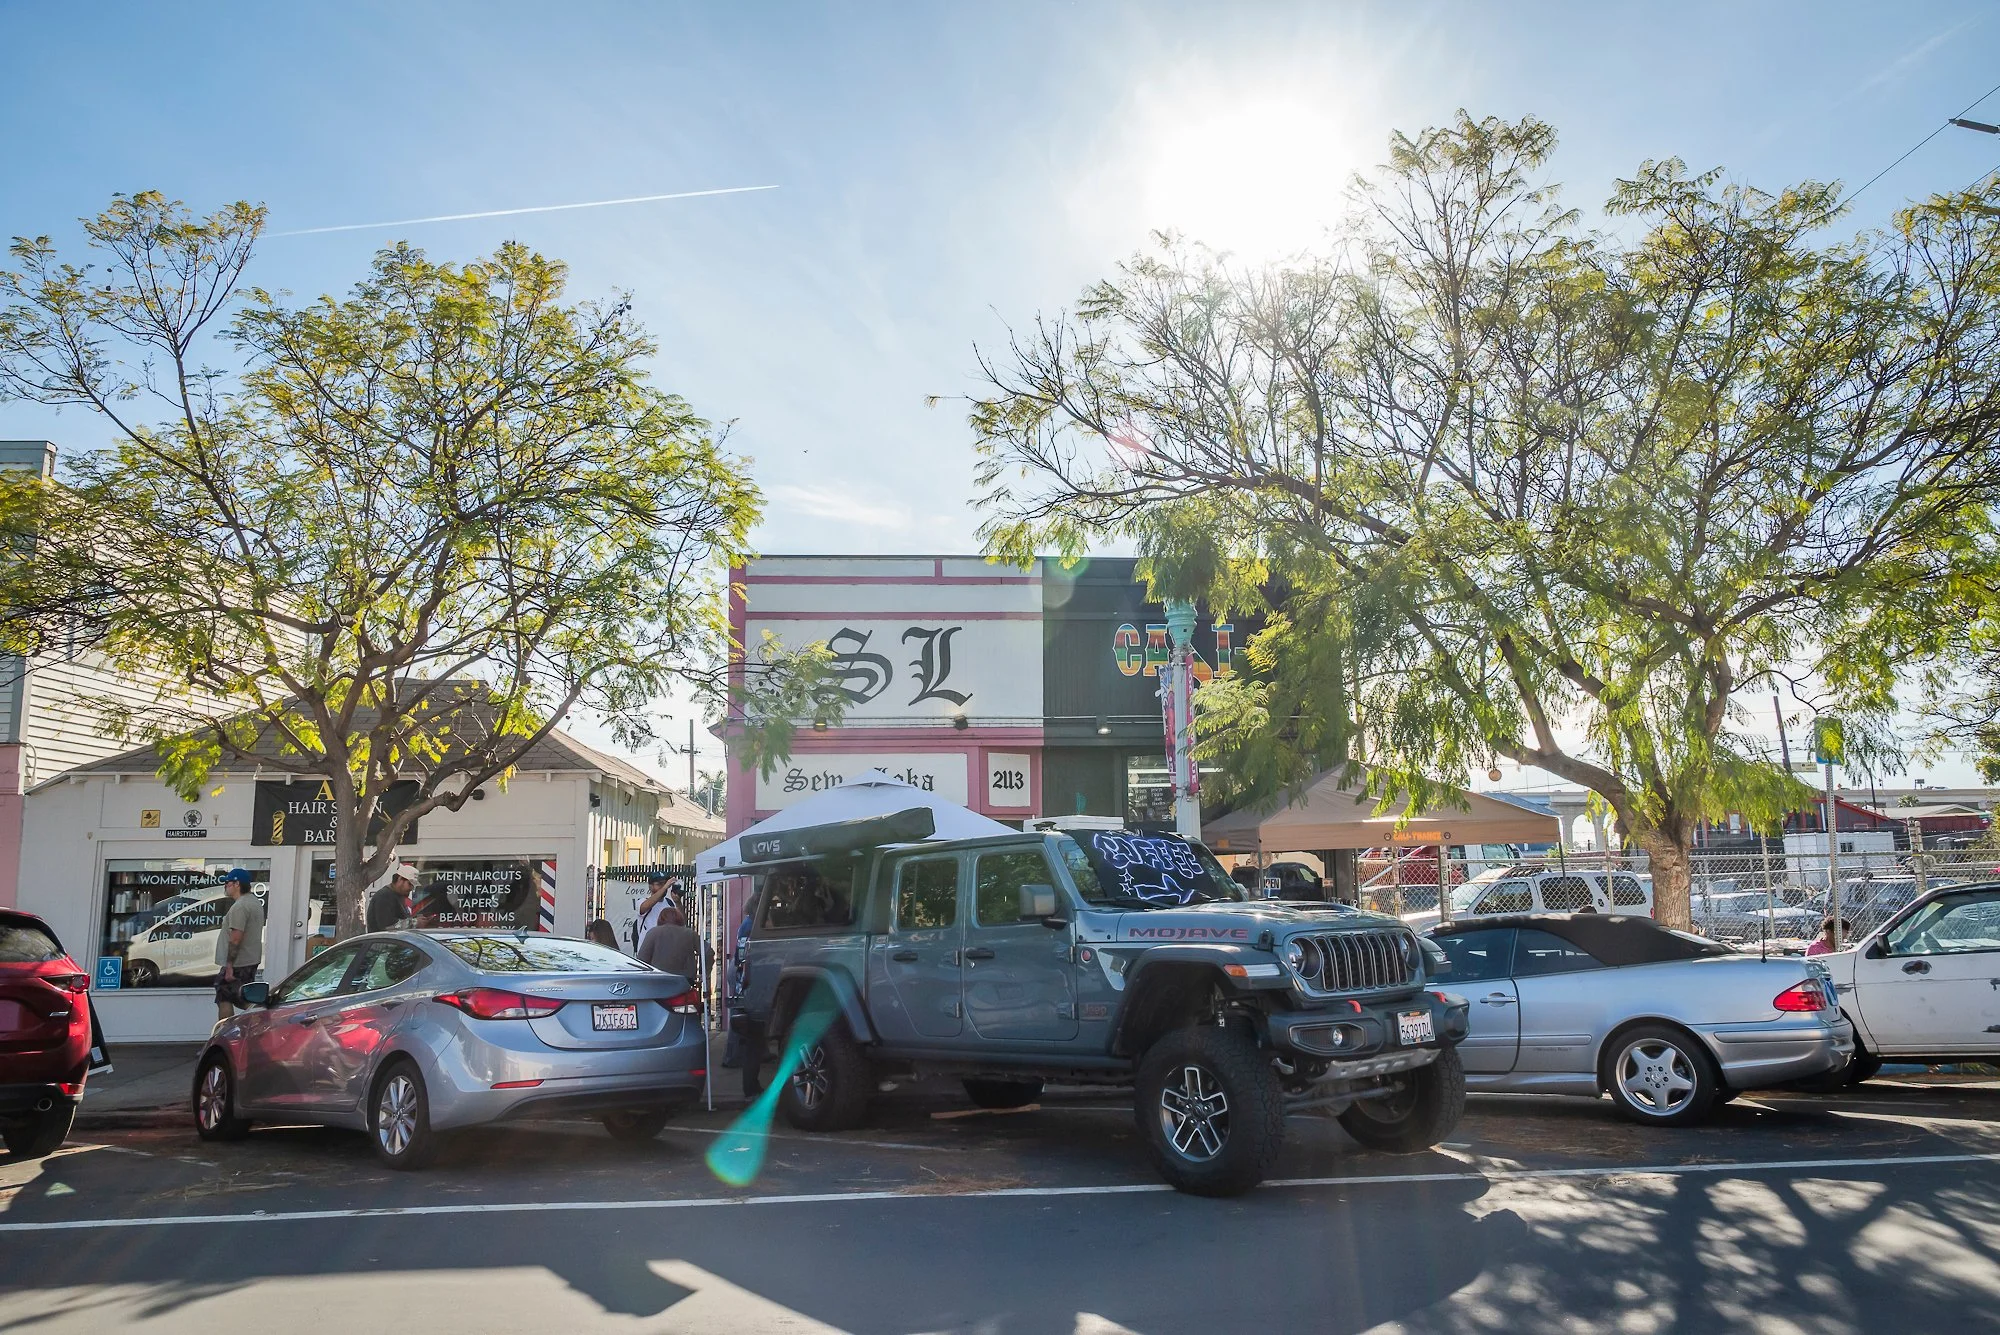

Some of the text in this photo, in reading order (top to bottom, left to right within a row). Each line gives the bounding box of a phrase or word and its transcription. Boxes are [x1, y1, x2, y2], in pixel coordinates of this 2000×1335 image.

[784, 767, 843, 793] Sew
[992, 770, 1025, 790] 2113
[288, 801, 327, 814] HAIR
[140, 875, 184, 885] WOMEN
[436, 871, 522, 881] MEN HAIRCUTS
[446, 884, 511, 895] SKIN FADES
[625, 885, 646, 895] Love
[167, 902, 217, 913] KERATIN
[457, 898, 500, 908] TAPERS
[439, 912, 516, 922] BEARD TRIMS
[1129, 927, 1249, 940] MOJAVE
[596, 1013, 636, 1026] 7KIF672
